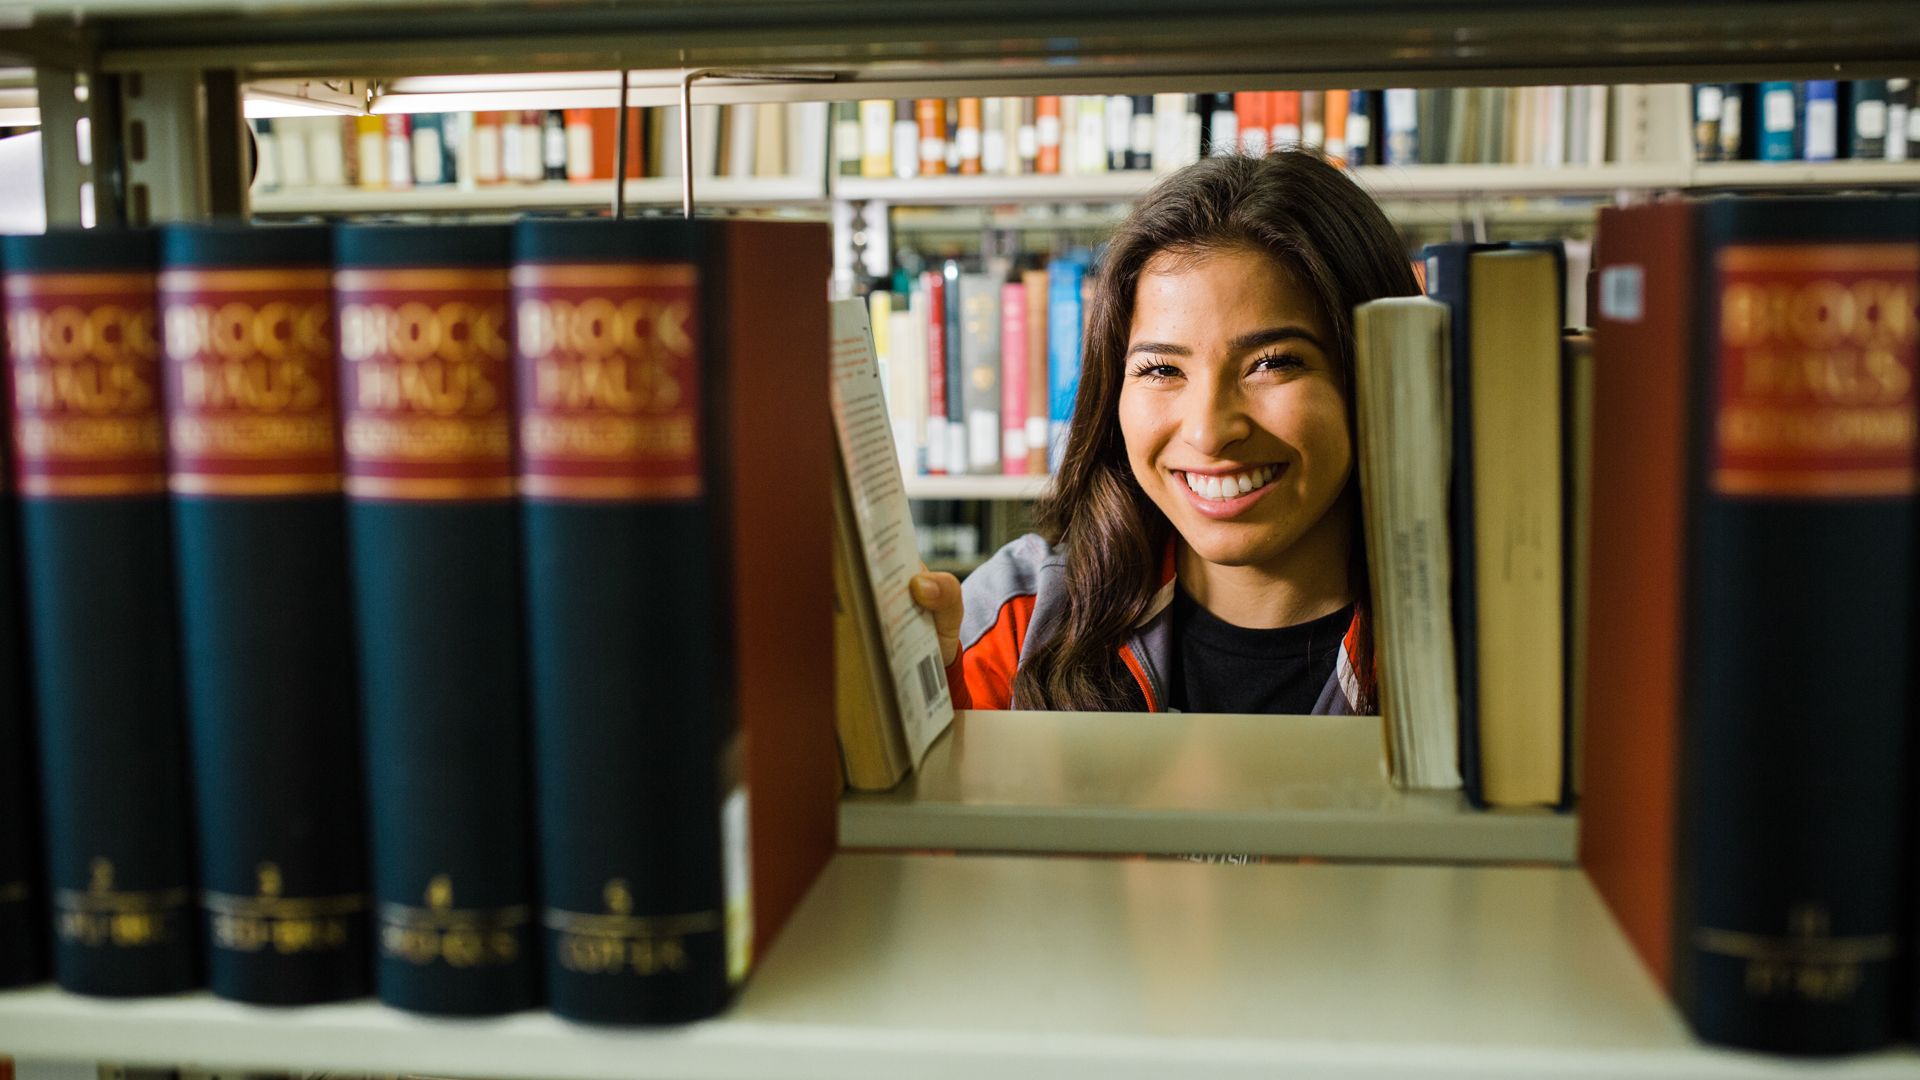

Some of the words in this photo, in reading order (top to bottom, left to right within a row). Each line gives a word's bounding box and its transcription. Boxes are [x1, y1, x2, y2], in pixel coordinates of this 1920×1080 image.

[164, 303, 332, 360] BROCK
[341, 302, 507, 360] BROCK
[517, 298, 693, 358] BROCK
[182, 359, 322, 412] HAUS
[357, 360, 497, 414] HAUS
[535, 358, 682, 414] HAUS
